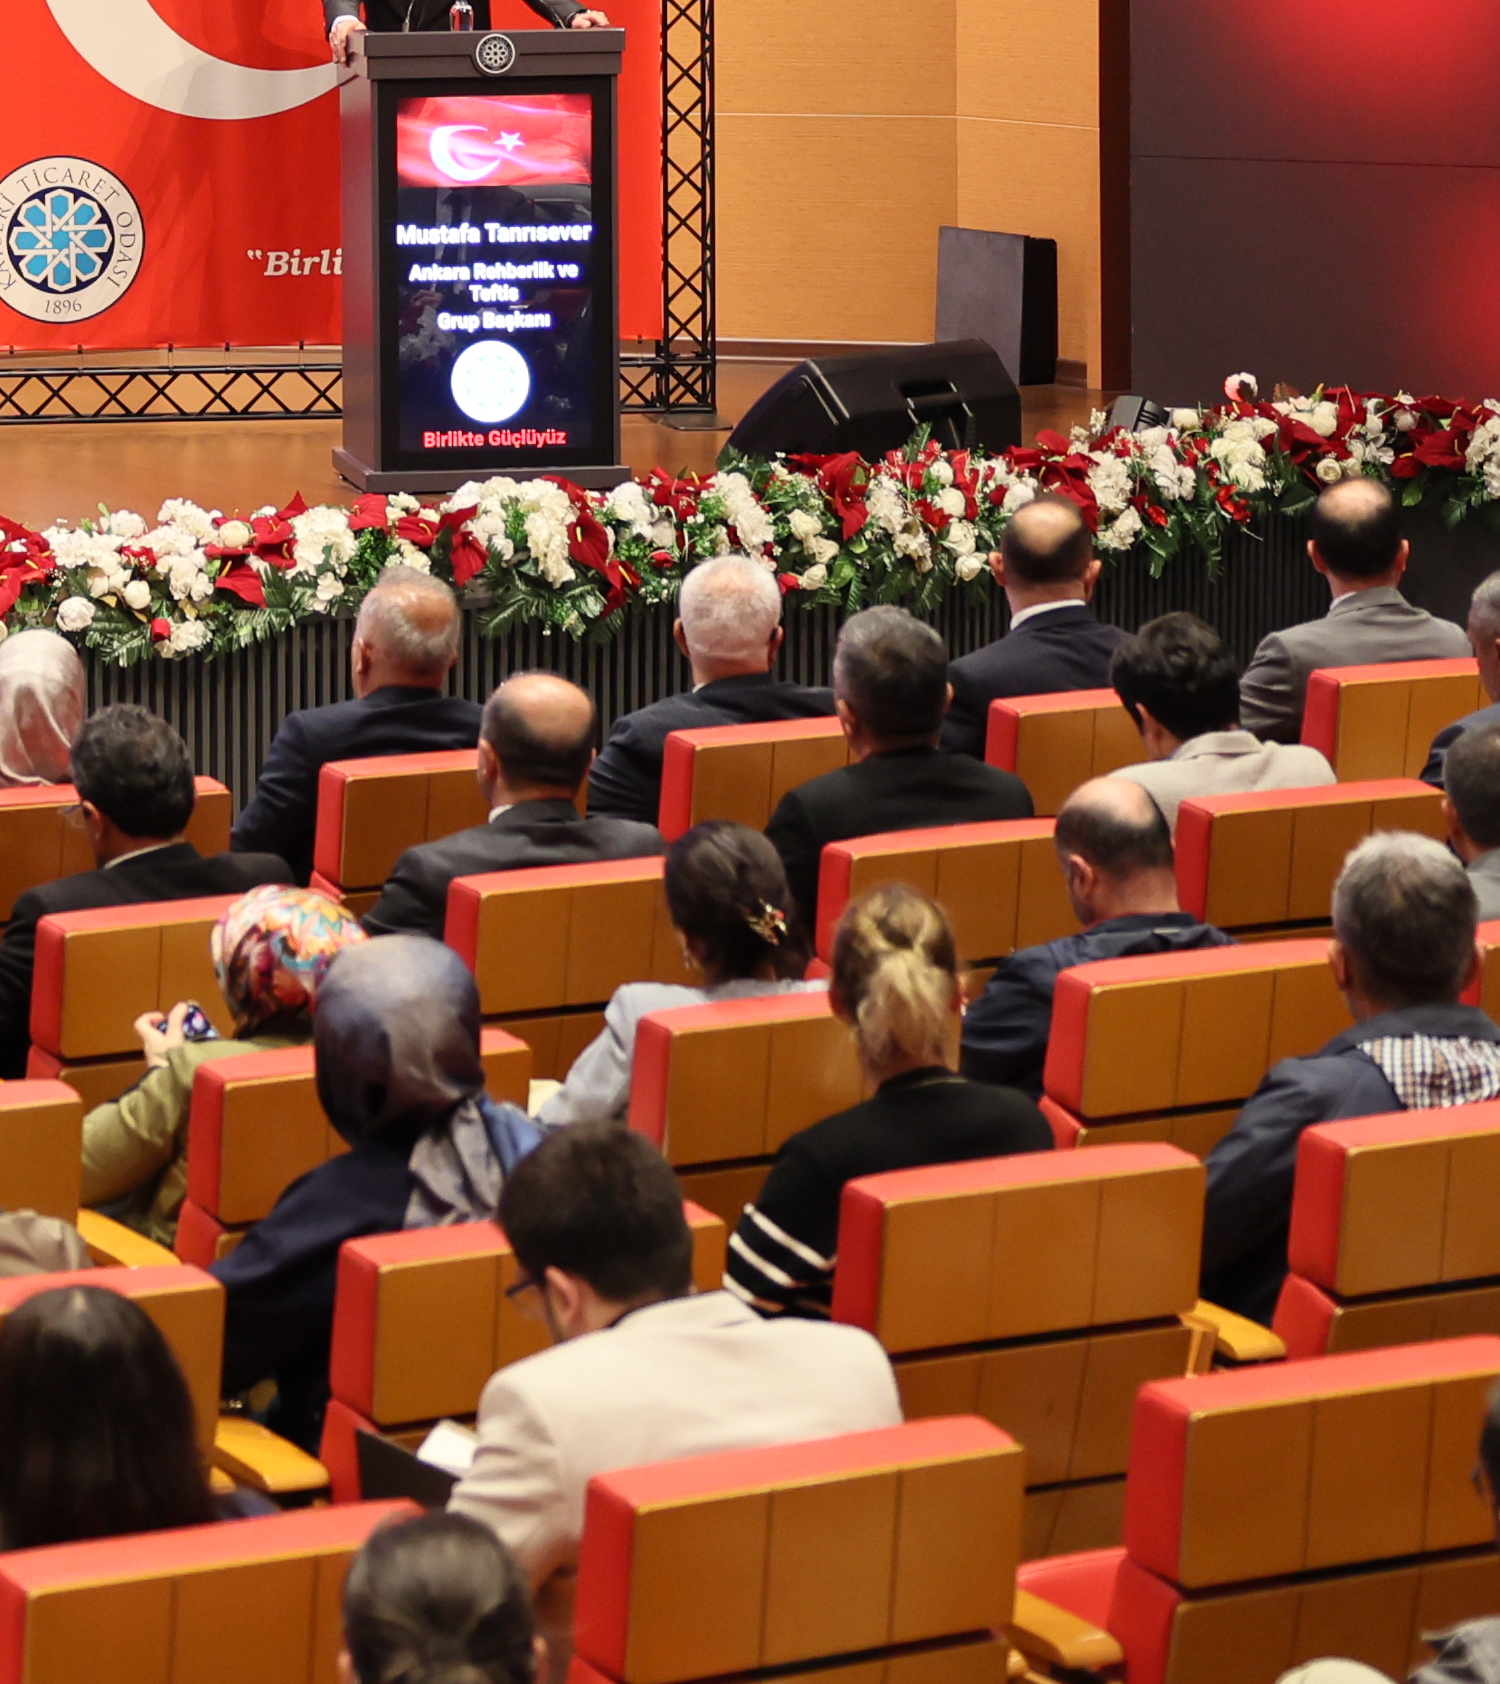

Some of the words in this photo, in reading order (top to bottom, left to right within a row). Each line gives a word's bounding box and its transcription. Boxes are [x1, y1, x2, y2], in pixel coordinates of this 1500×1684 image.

[17, 167, 120, 202] TİCARET
[106, 212, 136, 288] ODASI
[396, 222, 481, 245] Mustafa
[483, 222, 593, 243] Tanrısever
[247, 248, 342, 276] “Birli
[408, 263, 471, 282] Ankara
[473, 260, 555, 281] Rehberlik
[556, 263, 579, 278] ve
[44, 299, 82, 315] 1896
[436, 312, 481, 333] Grup
[482, 310, 551, 333] Başkanı
[423, 431, 484, 448] Birlikte
[488, 429, 566, 448] Güçlüyüz
